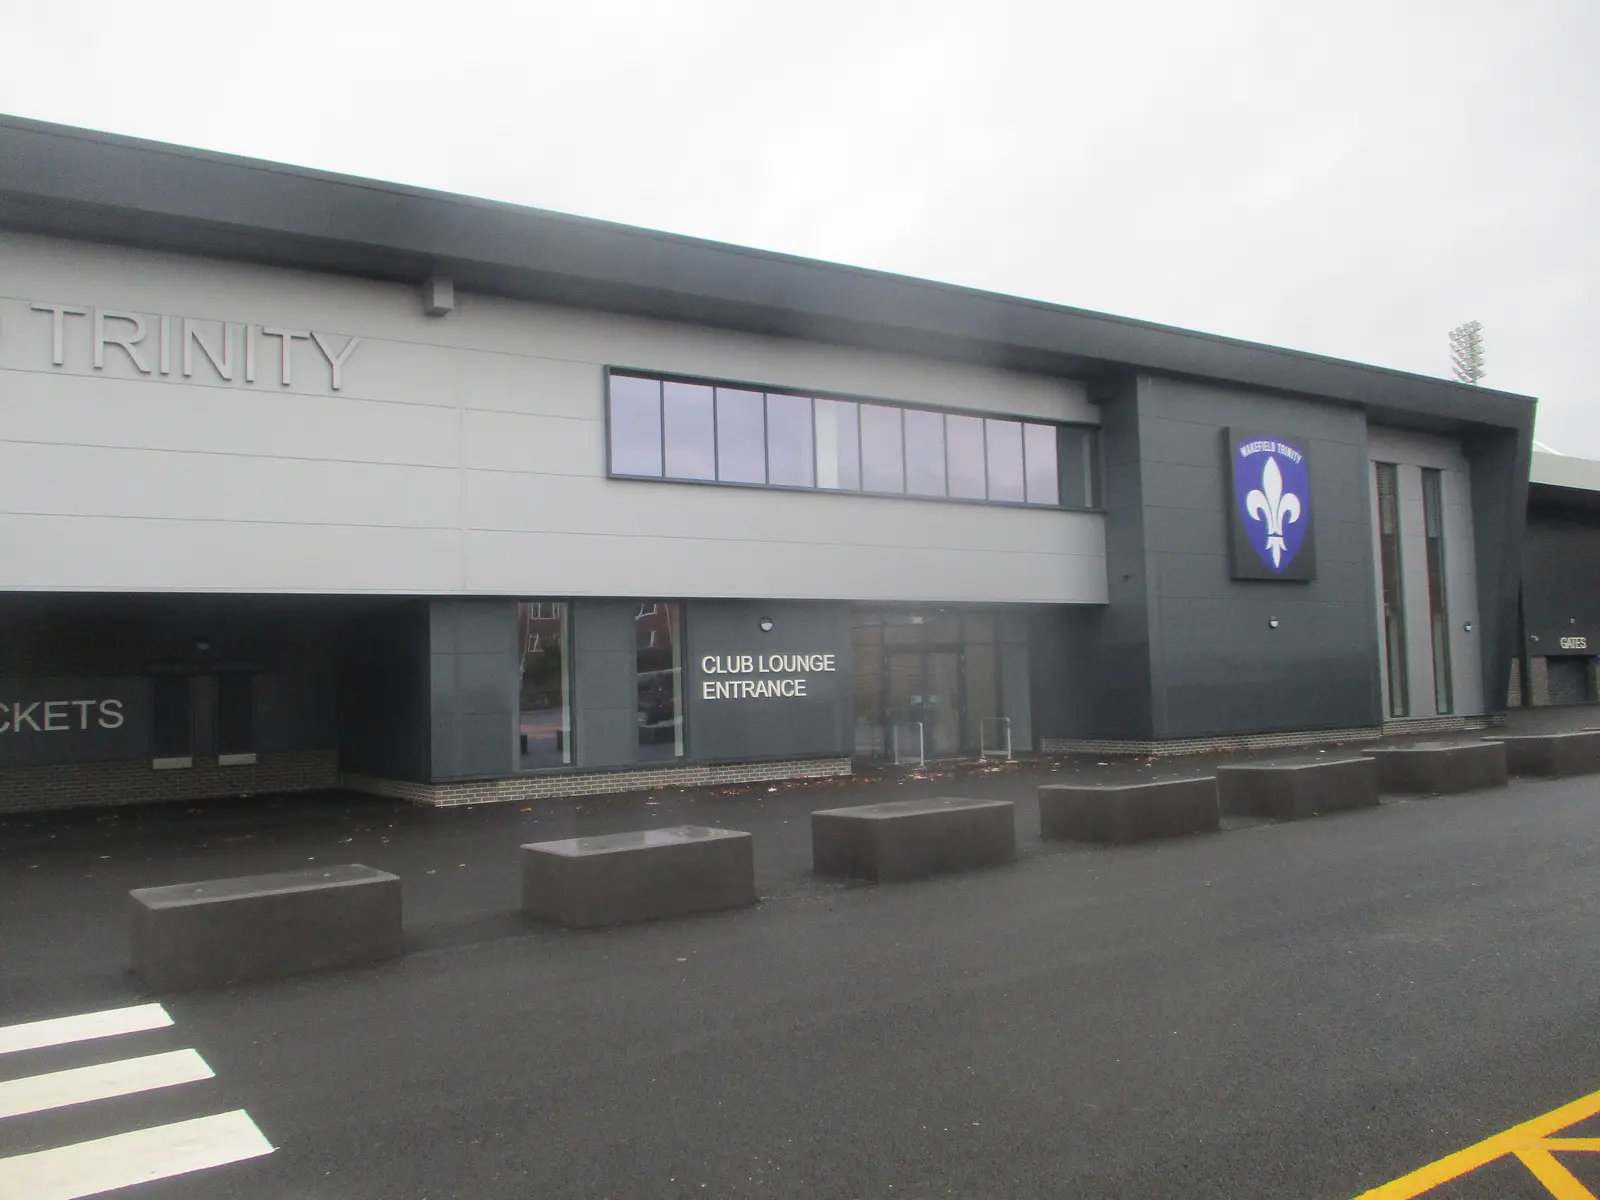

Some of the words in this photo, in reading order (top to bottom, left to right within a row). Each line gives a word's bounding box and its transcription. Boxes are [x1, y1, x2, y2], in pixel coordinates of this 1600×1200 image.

[29, 301, 360, 390] TRINITY
[1240, 440, 1275, 458] WAKEFIELD
[1276, 442, 1303, 464] TRINITY
[1560, 636, 1587, 649] GATES
[701, 655, 754, 674] CLUB
[758, 654, 836, 673] LOUNGE
[702, 679, 807, 700] ENTRANCE
